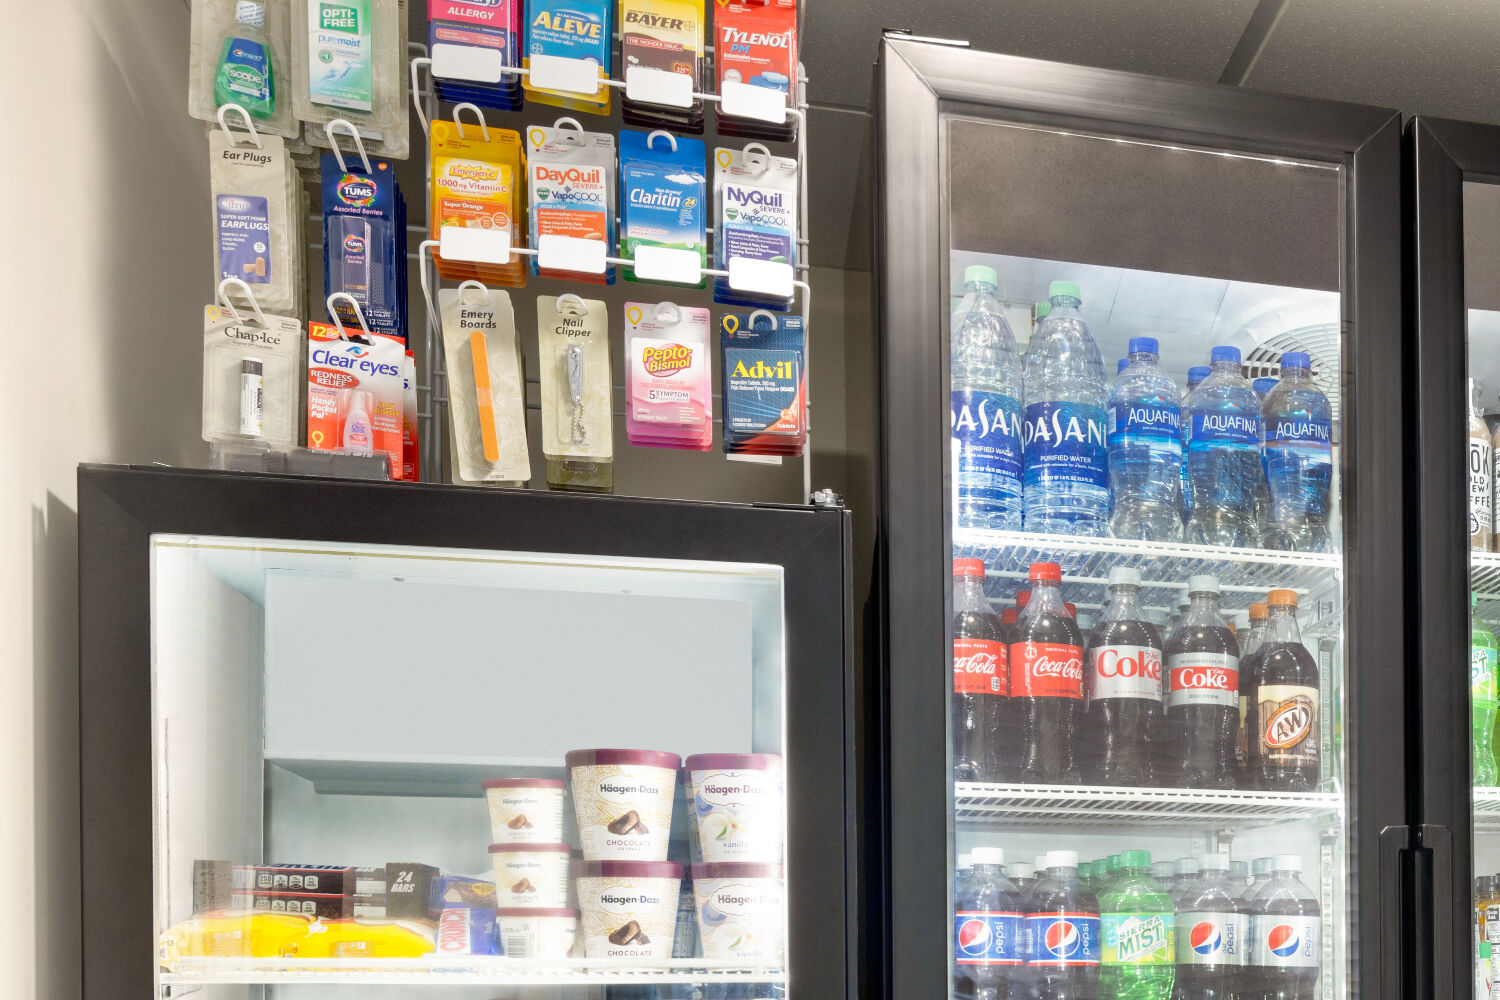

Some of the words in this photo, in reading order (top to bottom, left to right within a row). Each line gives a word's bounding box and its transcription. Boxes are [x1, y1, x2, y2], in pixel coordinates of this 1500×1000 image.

[321, 8, 355, 19] OPTI-
[447, 6, 495, 20] ALLERGY
[322, 18, 356, 28] FREE
[532, 11, 602, 39] ALEVE
[625, 12, 683, 31] BAYER
[318, 34, 361, 48] puremoist
[722, 26, 790, 49] TYLENOL
[730, 44, 750, 54] PM
[222, 150, 249, 161] Ear
[242, 151, 272, 165] Plugs
[536, 166, 600, 186] DayQuil
[343, 186, 373, 198] TUMS
[630, 188, 681, 208] Claritin
[727, 186, 783, 208] NyQuil
[333, 205, 358, 215] Assorted
[359, 206, 383, 217] Berries
[221, 219, 269, 232] EARPLUGS
[460, 309, 494, 322] Emery
[562, 317, 583, 328] Nail
[460, 319, 497, 330] Boards
[312, 326, 326, 338] 12
[555, 326, 592, 339] Clipper
[312, 349, 357, 370] Clear
[643, 344, 692, 361] Pepto-
[649, 357, 691, 372] Bismol
[730, 360, 793, 380] Advil
[310, 369, 352, 383] REDNESS
[317, 377, 347, 388] RELIEF
[311, 396, 337, 407] Handy
[311, 403, 338, 415] Pocket
[1127, 407, 1181, 429] AQUAFINA
[1201, 415, 1258, 434] AQUAFINA
[1039, 454, 1069, 464] PURIFIED
[1069, 455, 1092, 465] WATER
[1097, 648, 1162, 679] Coke
[1179, 668, 1229, 688] Coke
[440, 908, 466, 952] CRUNCH
[1118, 914, 1161, 939] SIERRA
[1117, 928, 1164, 959] MIST
[607, 949, 653, 957] CHOCOLATE
